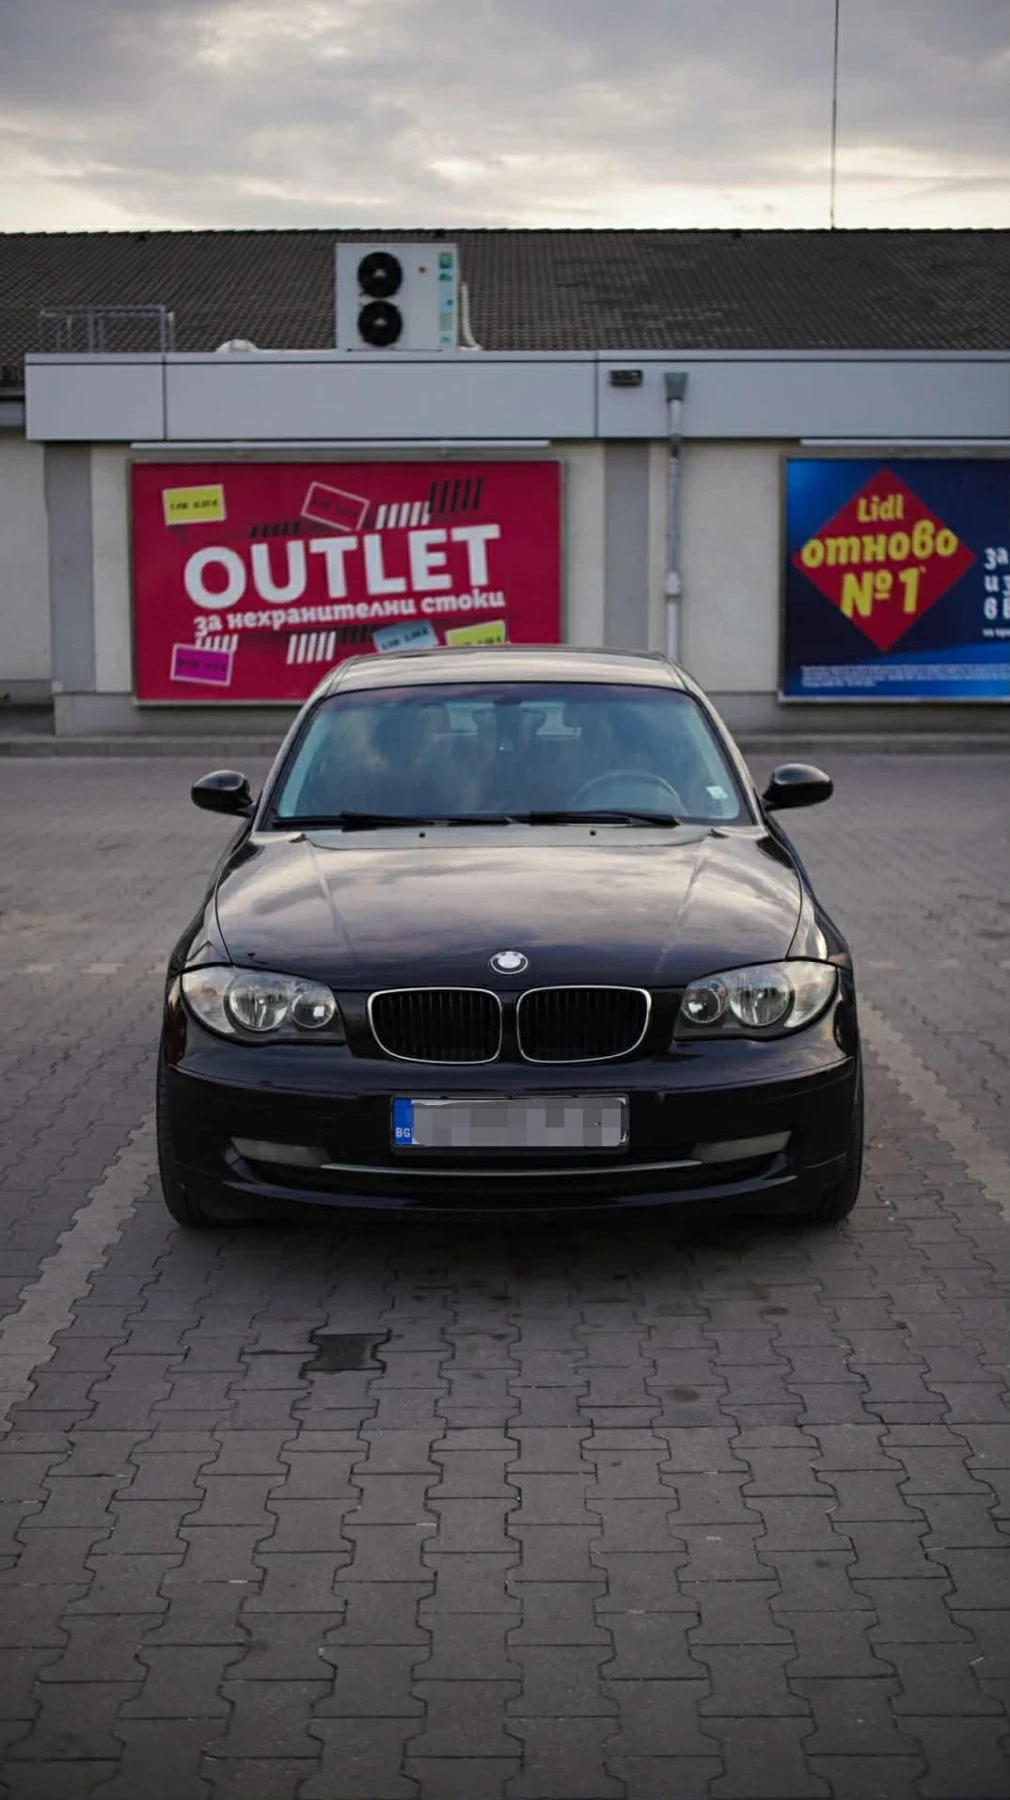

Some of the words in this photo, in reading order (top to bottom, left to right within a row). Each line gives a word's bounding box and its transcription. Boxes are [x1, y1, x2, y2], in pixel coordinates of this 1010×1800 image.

[857, 493, 904, 523] Lidl
[184, 524, 501, 610] OUTLET
[801, 519, 959, 568] отново
[194, 613, 222, 640] за
[228, 596, 416, 631] нехранителни
[421, 588, 506, 614] стоки
[395, 1127, 411, 1138] BG
